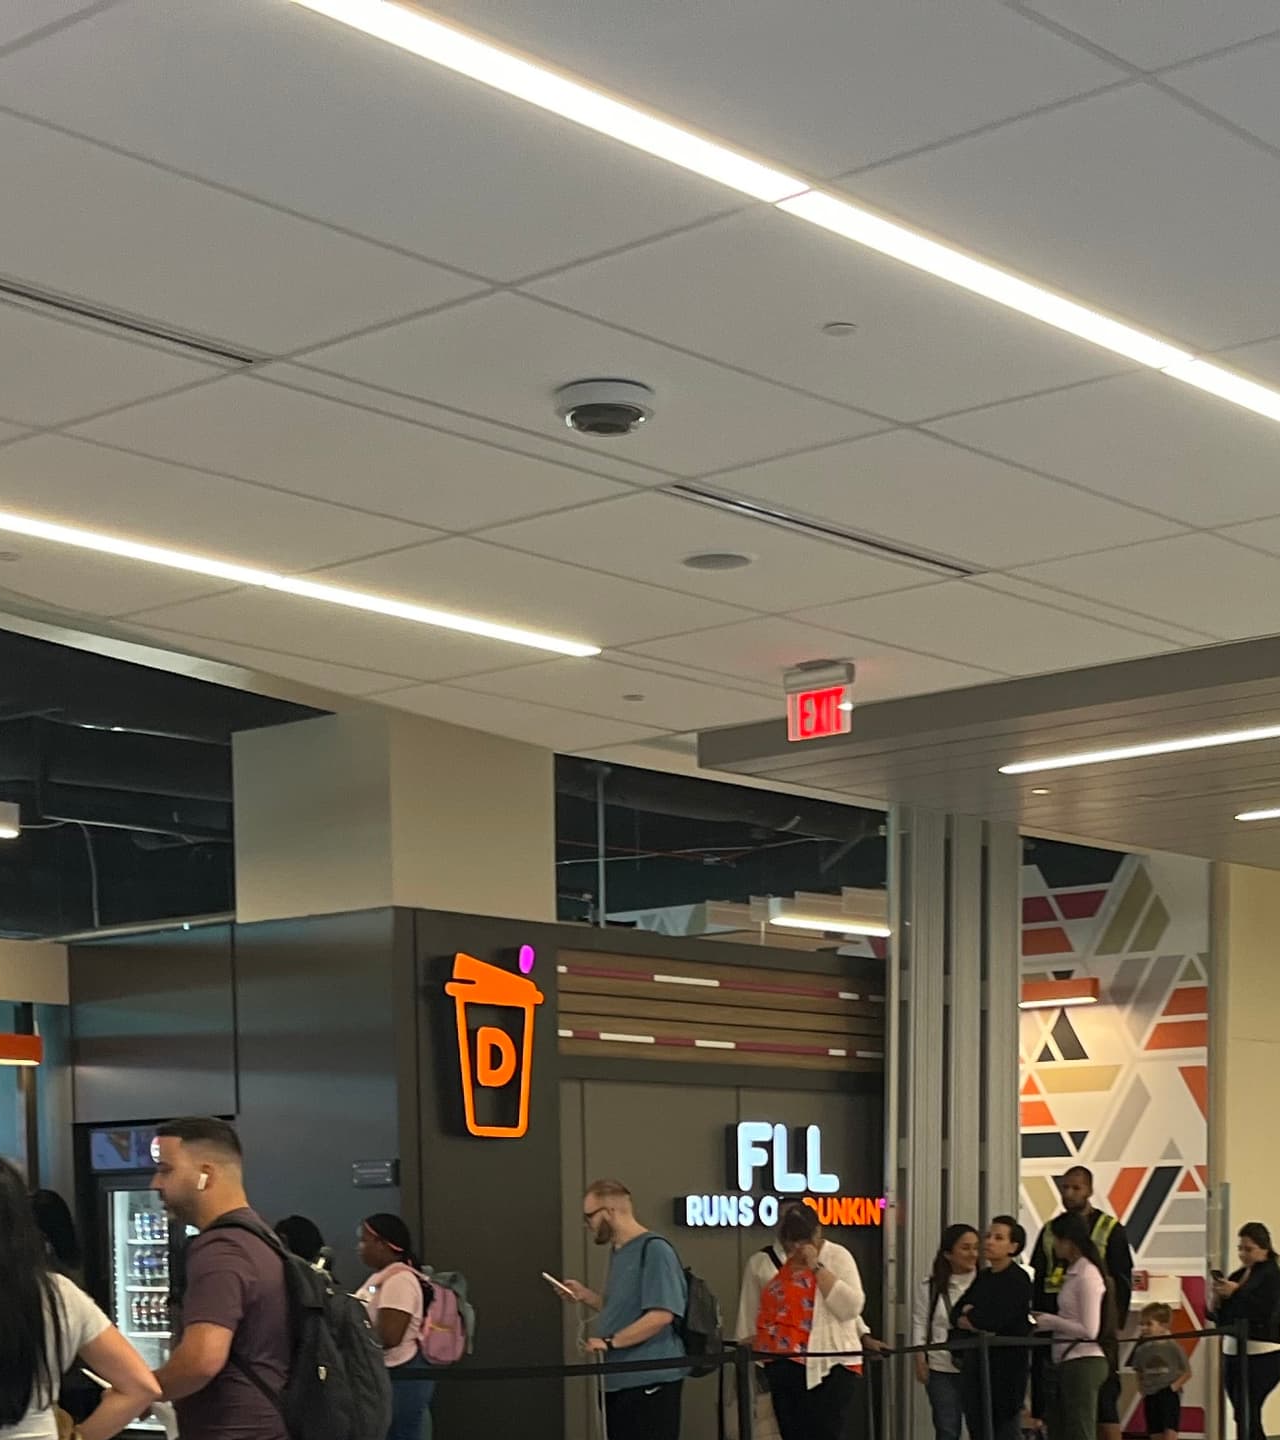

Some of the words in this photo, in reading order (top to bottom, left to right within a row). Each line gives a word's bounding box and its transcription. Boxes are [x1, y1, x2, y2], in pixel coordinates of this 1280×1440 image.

[476, 1026, 517, 1088] D
[737, 1121, 840, 1193] FLL
[686, 1195, 754, 1226] RUNS
[758, 1195, 784, 1226] O
